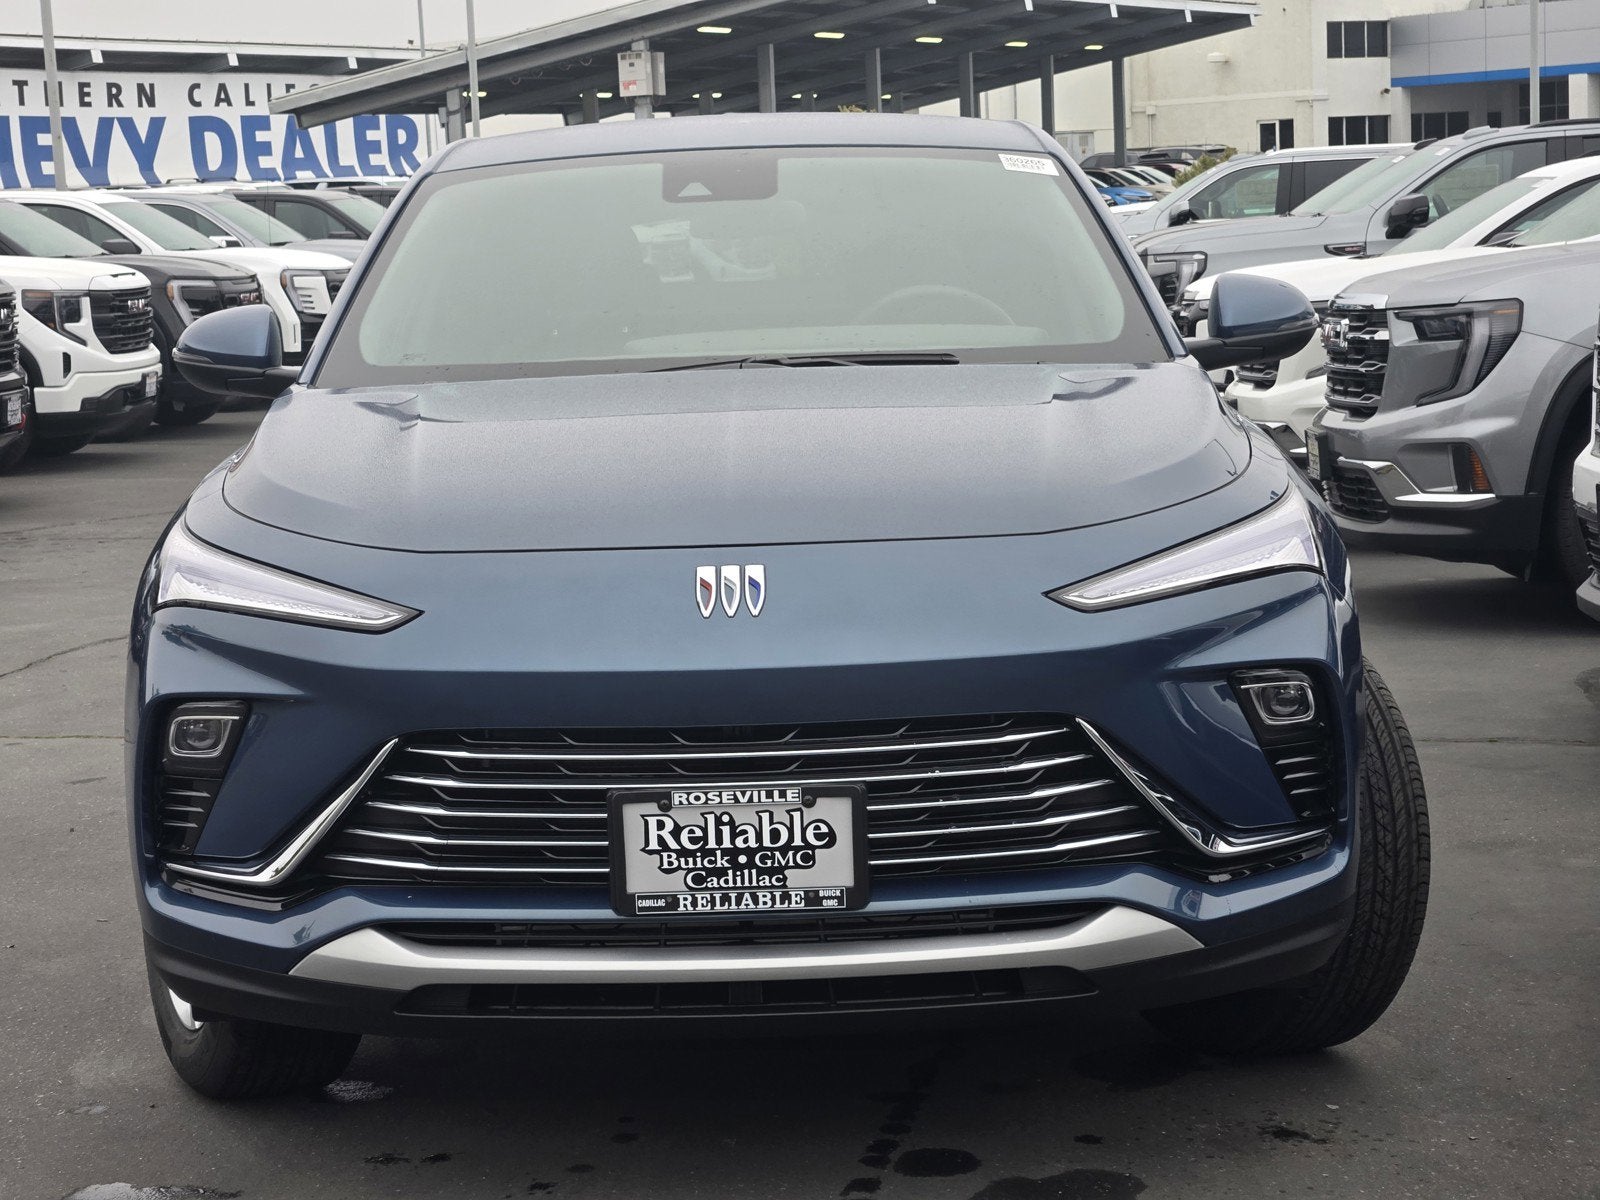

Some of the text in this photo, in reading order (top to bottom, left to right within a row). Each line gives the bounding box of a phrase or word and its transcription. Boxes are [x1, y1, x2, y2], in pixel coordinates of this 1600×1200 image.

[187, 82, 319, 107] CALI
[188, 114, 422, 183] DEALER
[673, 789, 800, 806] ROSEVILLE
[643, 809, 830, 851] Reliable
[661, 850, 814, 869] Buick GMC
[686, 871, 785, 888] Cadillac
[638, 898, 666, 907] CADILLAC
[677, 890, 805, 911] RELIABLE
[819, 889, 841, 897] BUICK
